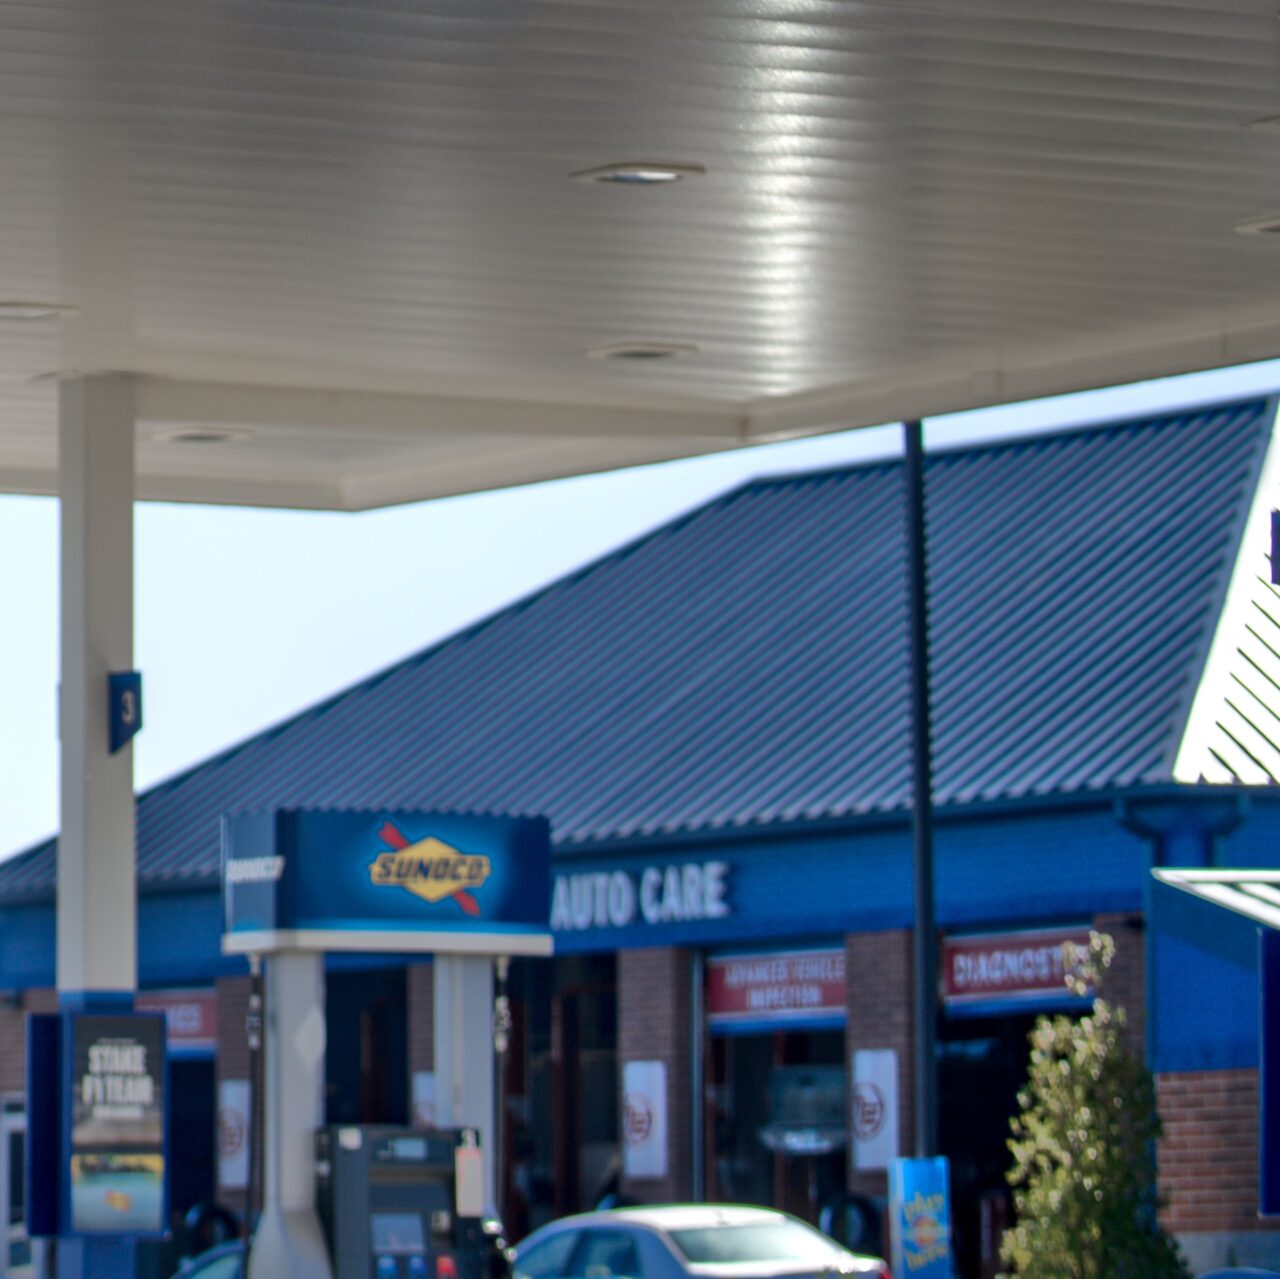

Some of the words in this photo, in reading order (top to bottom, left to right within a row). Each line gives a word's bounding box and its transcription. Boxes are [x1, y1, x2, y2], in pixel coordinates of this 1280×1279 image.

[378, 856, 485, 881] SUNOCO
[550, 870, 635, 931] AUTO
[640, 861, 730, 924] CARE
